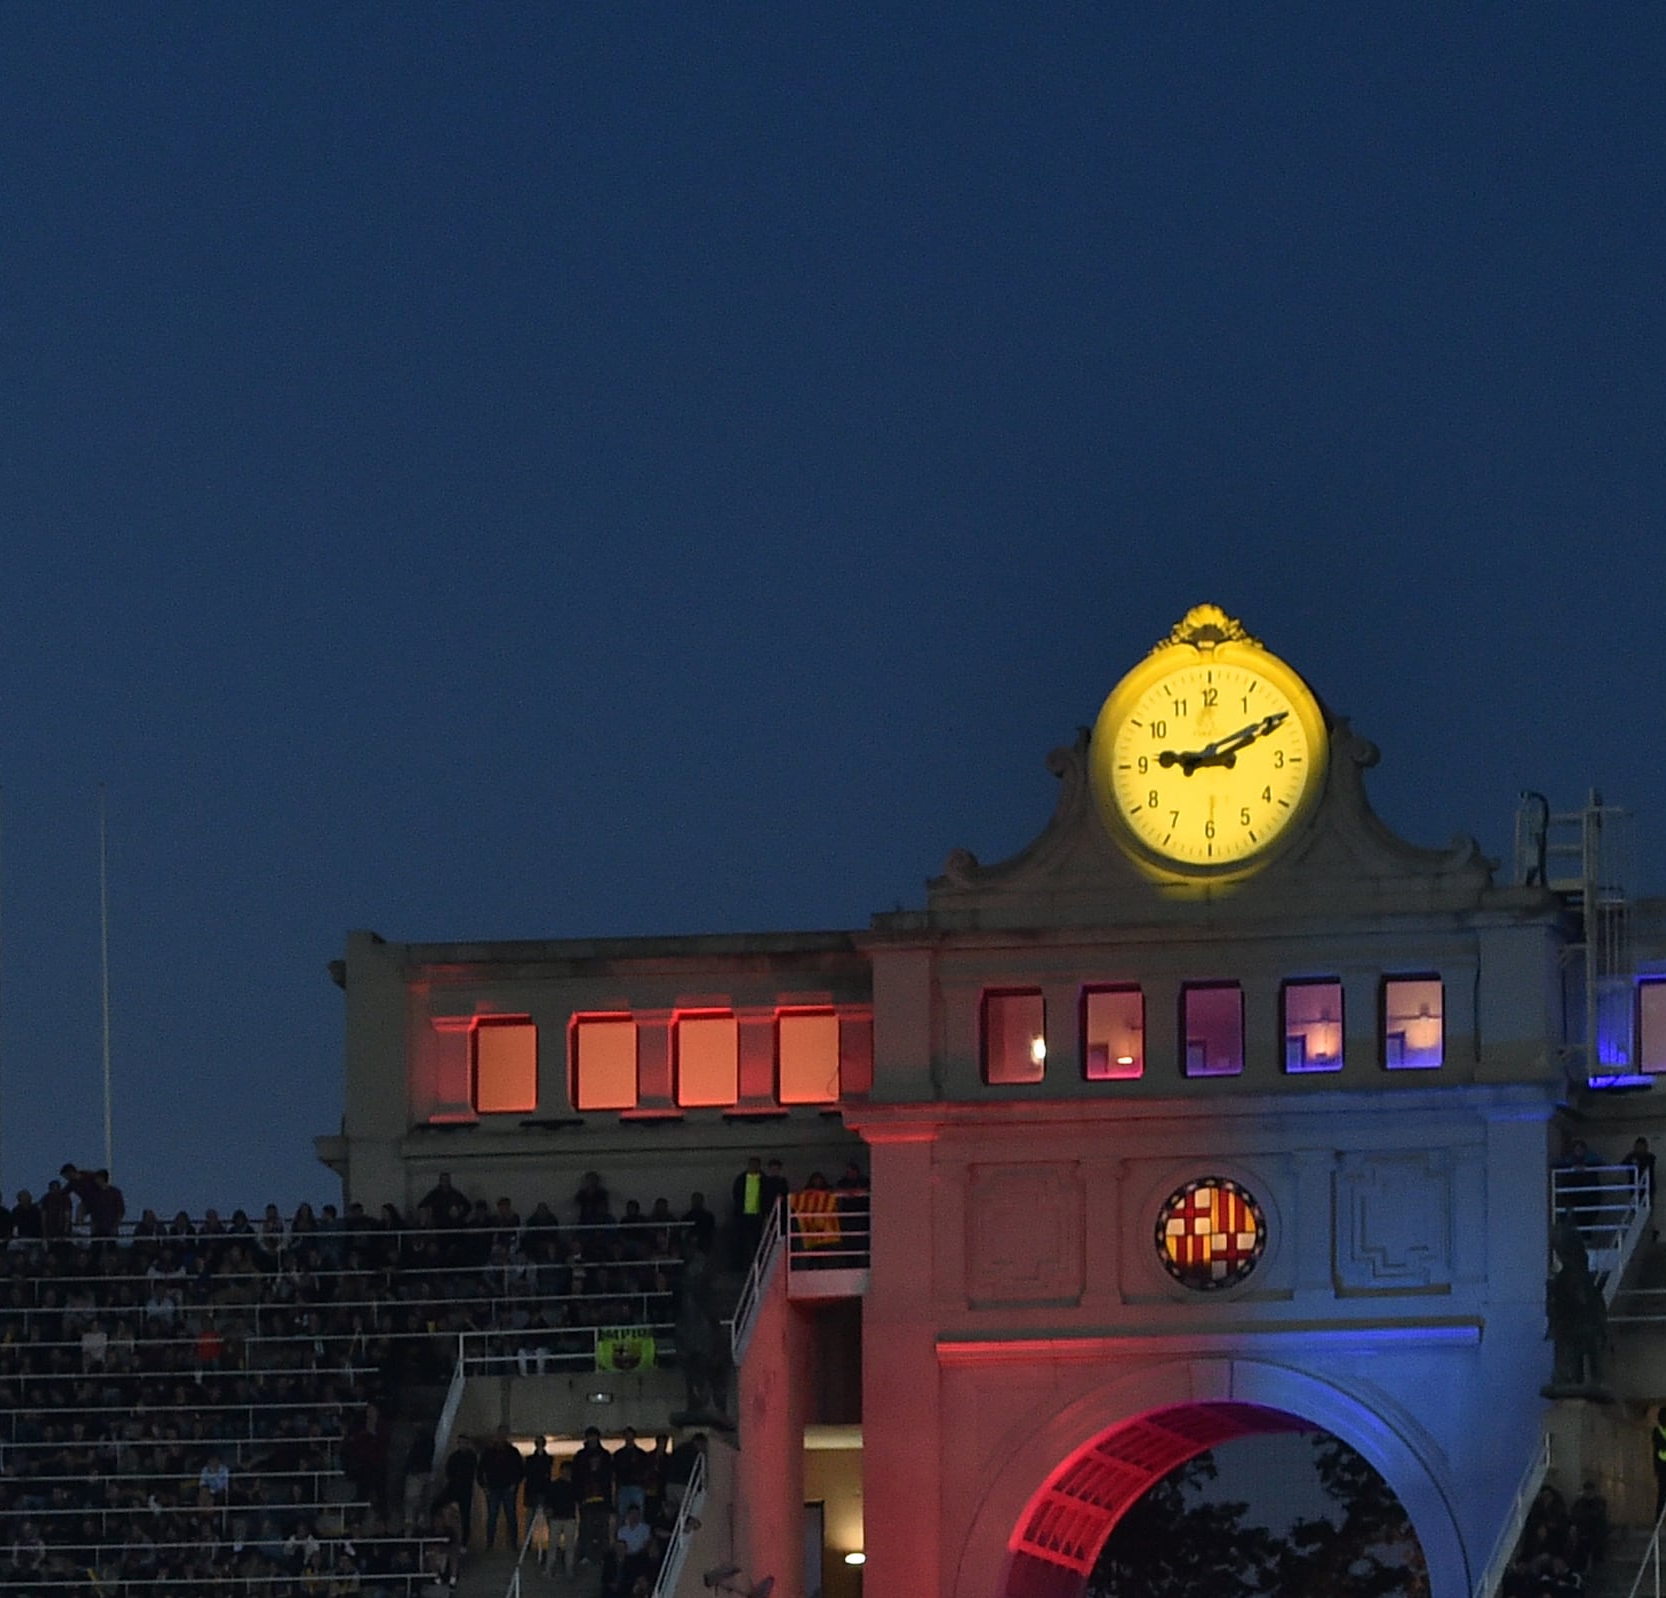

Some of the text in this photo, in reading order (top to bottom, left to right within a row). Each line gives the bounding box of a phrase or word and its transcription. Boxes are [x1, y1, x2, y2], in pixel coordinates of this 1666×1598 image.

[1202, 687, 1218, 707] 12
[1242, 695, 1248, 714] 1
[1173, 698, 1187, 717] 11
[1150, 719, 1167, 739] 10
[1138, 755, 1148, 774] 9
[1274, 750, 1284, 769] 3
[1148, 789, 1159, 808] 8
[1262, 785, 1271, 803] 4
[1169, 810, 1180, 828] 7
[1240, 807, 1251, 826] 5
[1205, 819, 1215, 839] 6
